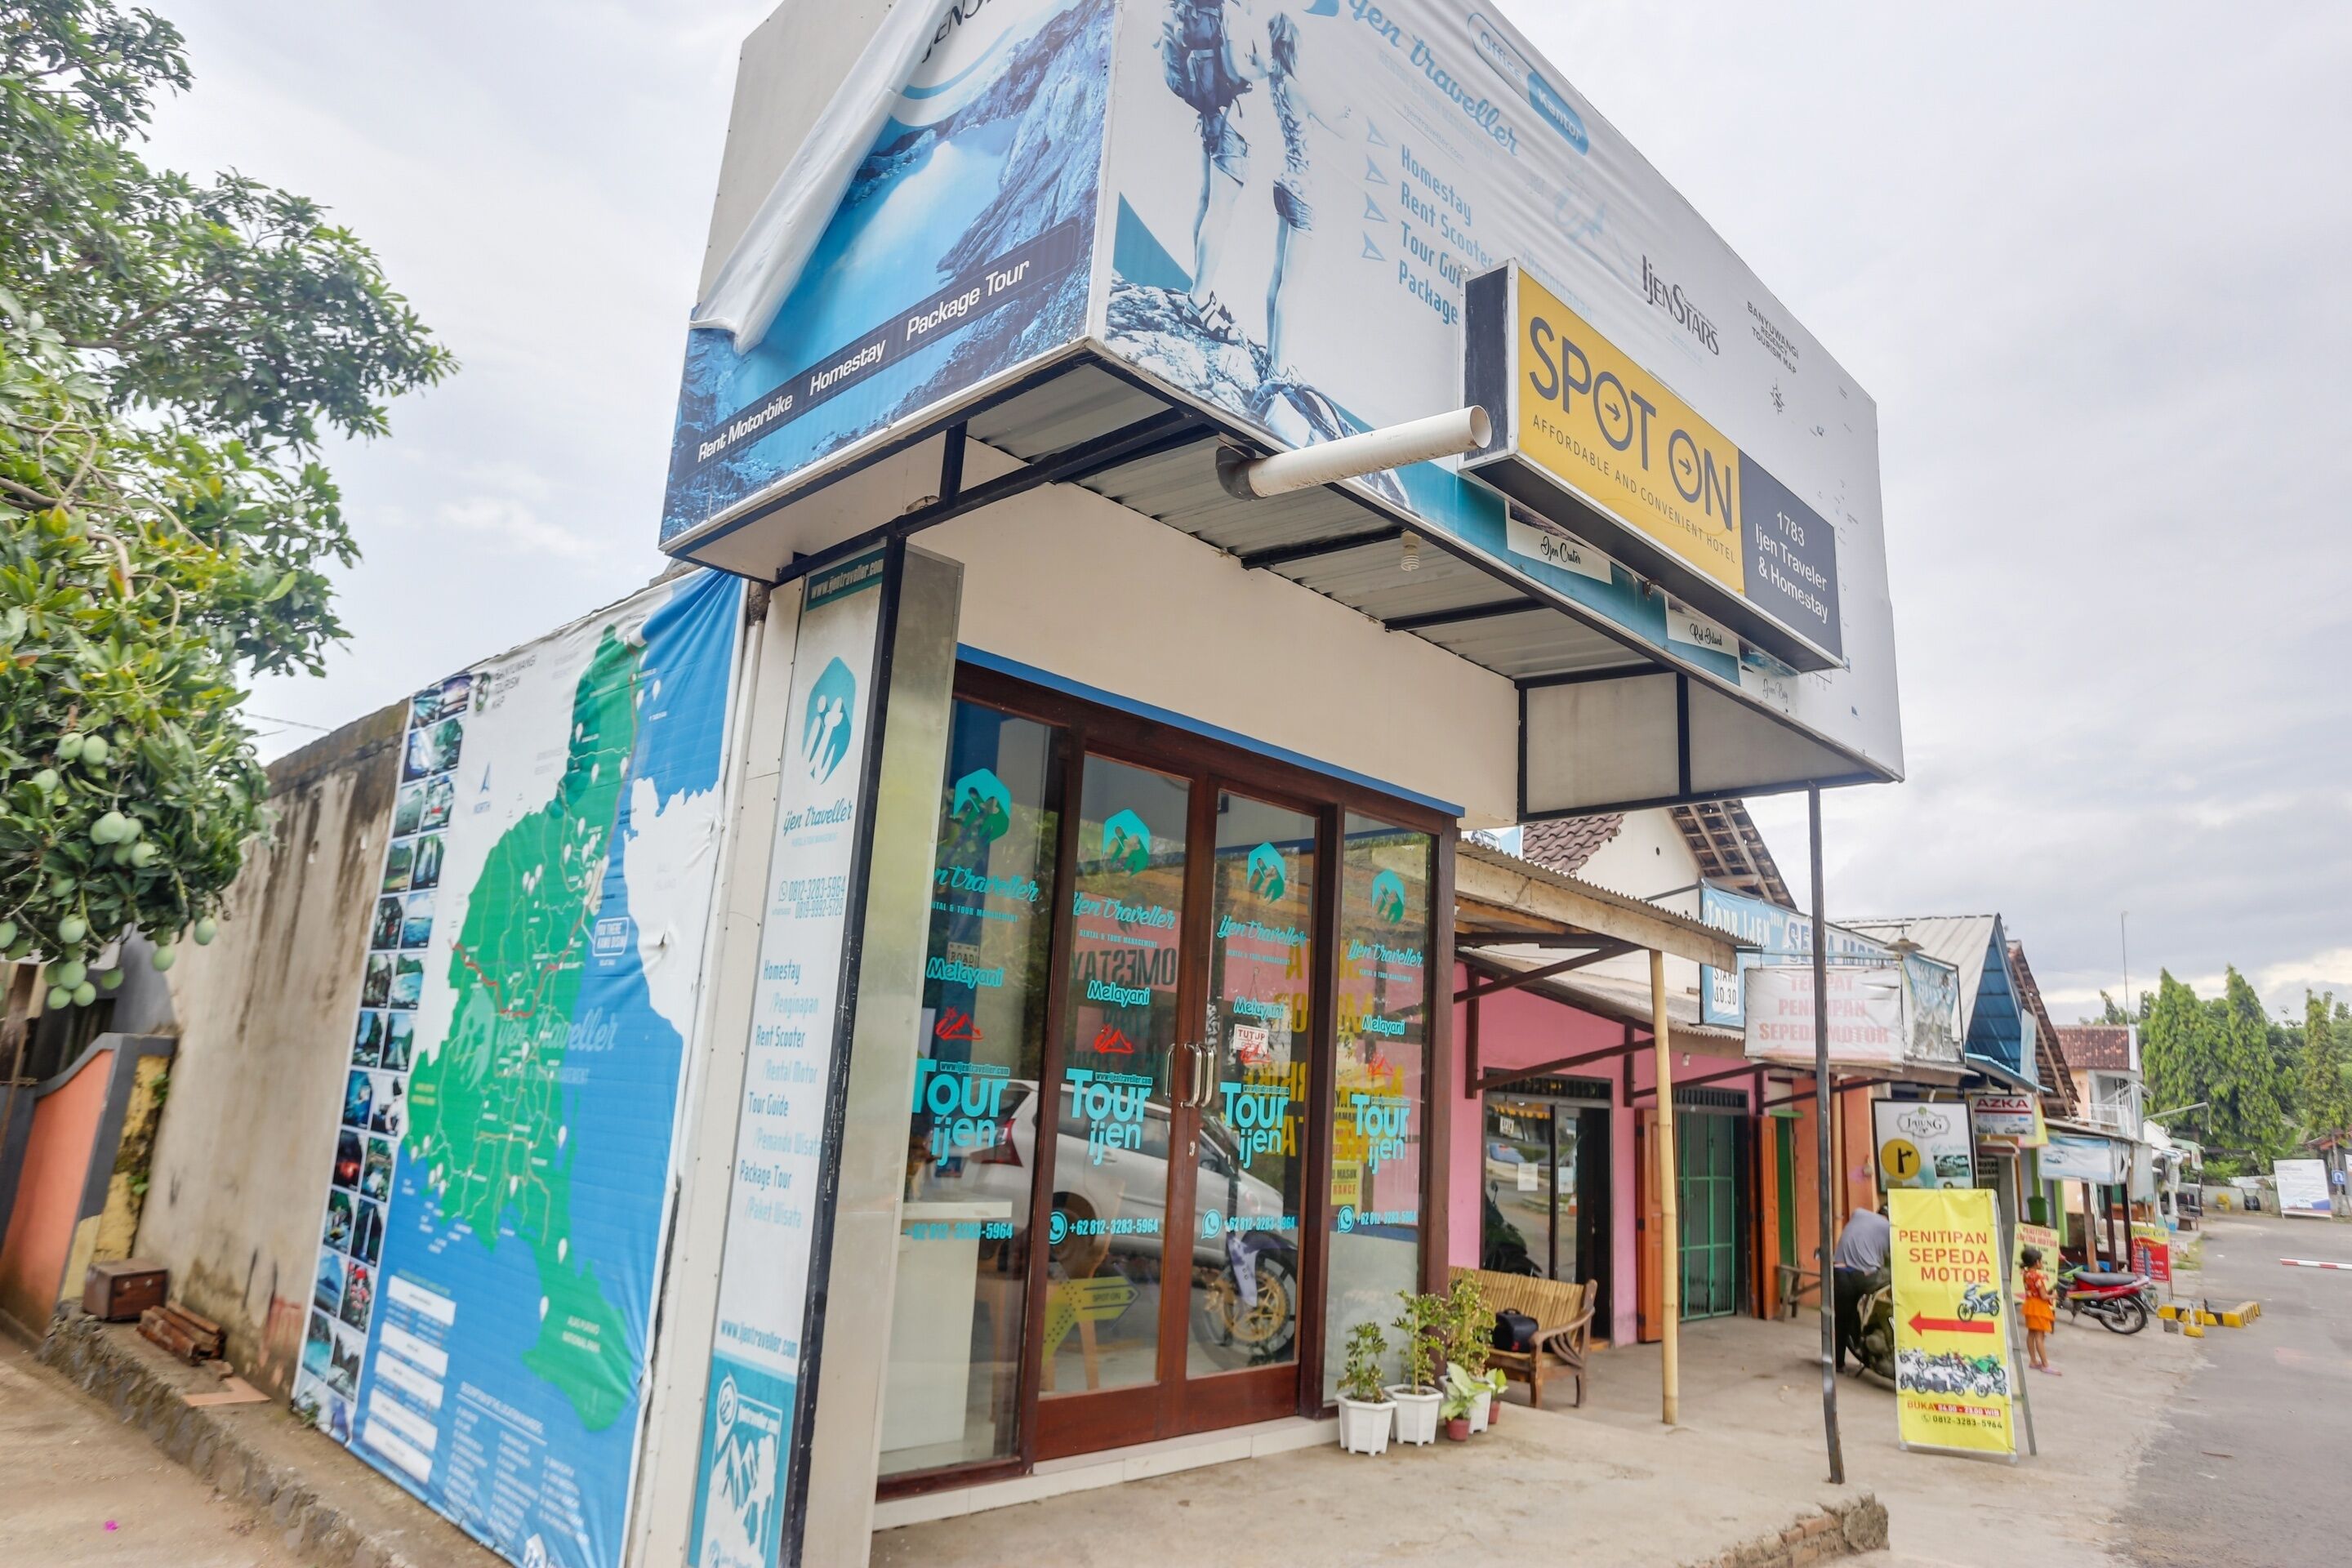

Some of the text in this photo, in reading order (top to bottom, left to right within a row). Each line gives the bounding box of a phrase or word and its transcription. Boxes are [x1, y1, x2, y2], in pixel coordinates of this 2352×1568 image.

[1480, 31, 1522, 81] Office
[1536, 86, 1581, 141] Kantor
[1402, 144, 1471, 227] Homestay
[1401, 180, 1494, 267] Rent Scooter
[1401, 220, 1462, 289] Tour Gui
[1399, 259, 1459, 326] Package
[1747, 301, 1799, 359] BANYUWANGI
[1761, 326, 1788, 356] REGENCY
[697, 260, 1030, 463] Rent Motorbike Homestay Package Tour
[1752, 327, 1797, 374] TOURISM MAP
[1530, 316, 1732, 532] SPOT ON
[1532, 414, 1736, 564] AFFORDABLE AND CONVENIENT HOTEL
[1776, 510, 1806, 547] 1783
[1560, 542, 1581, 566] Crater
[1755, 523, 1828, 593] Ijen Traveler
[1758, 558, 1829, 625] & Homestay
[805, 797, 853, 826] traveller
[957, 905, 974, 915] TOUR
[1102, 898, 1176, 929] traveller
[1707, 900, 1738, 936] TOUR
[1744, 910, 1771, 946] IJEN
[951, 951, 974, 964] ROAD
[1788, 921, 1834, 964] SEA
[764, 959, 801, 985] Homestay
[926, 956, 1004, 989] Melayani
[1790, 975, 1854, 993] TEPAT
[1087, 980, 1150, 1007] Melayani
[1779, 999, 1867, 1018] PENIIPAN
[755, 1025, 806, 1049] Rent Scooter
[1362, 1014, 1405, 1037] Melayani
[1827, 1025, 1889, 1044] MOTOR
[912, 1058, 1008, 1117] Tour
[1066, 1068, 1152, 1122] Tour
[1095, 1072, 1152, 1085] www.ijentraveller.com
[748, 1091, 789, 1117] Tour Guide
[1219, 1081, 1289, 1129] Tour
[1352, 1094, 1410, 1138] Tour
[1976, 1098, 2029, 1108] AZKA
[932, 1116, 996, 1166] ijen
[1089, 1120, 1141, 1165] ijen
[1239, 1129, 1281, 1169] ijen
[1369, 1137, 1404, 1174] ijen
[739, 1160, 792, 1190] Package Tour
[1333, 1185, 1356, 1195] RANCE
[1899, 1230, 1988, 1245] PENITIPAN
[1909, 1248, 1990, 1265] SEPEDA
[1921, 1266, 1990, 1284] MOTOR
[1908, 1400, 1934, 1410] BUKA
[1933, 1414, 2002, 1429] 0812-3283-5964
